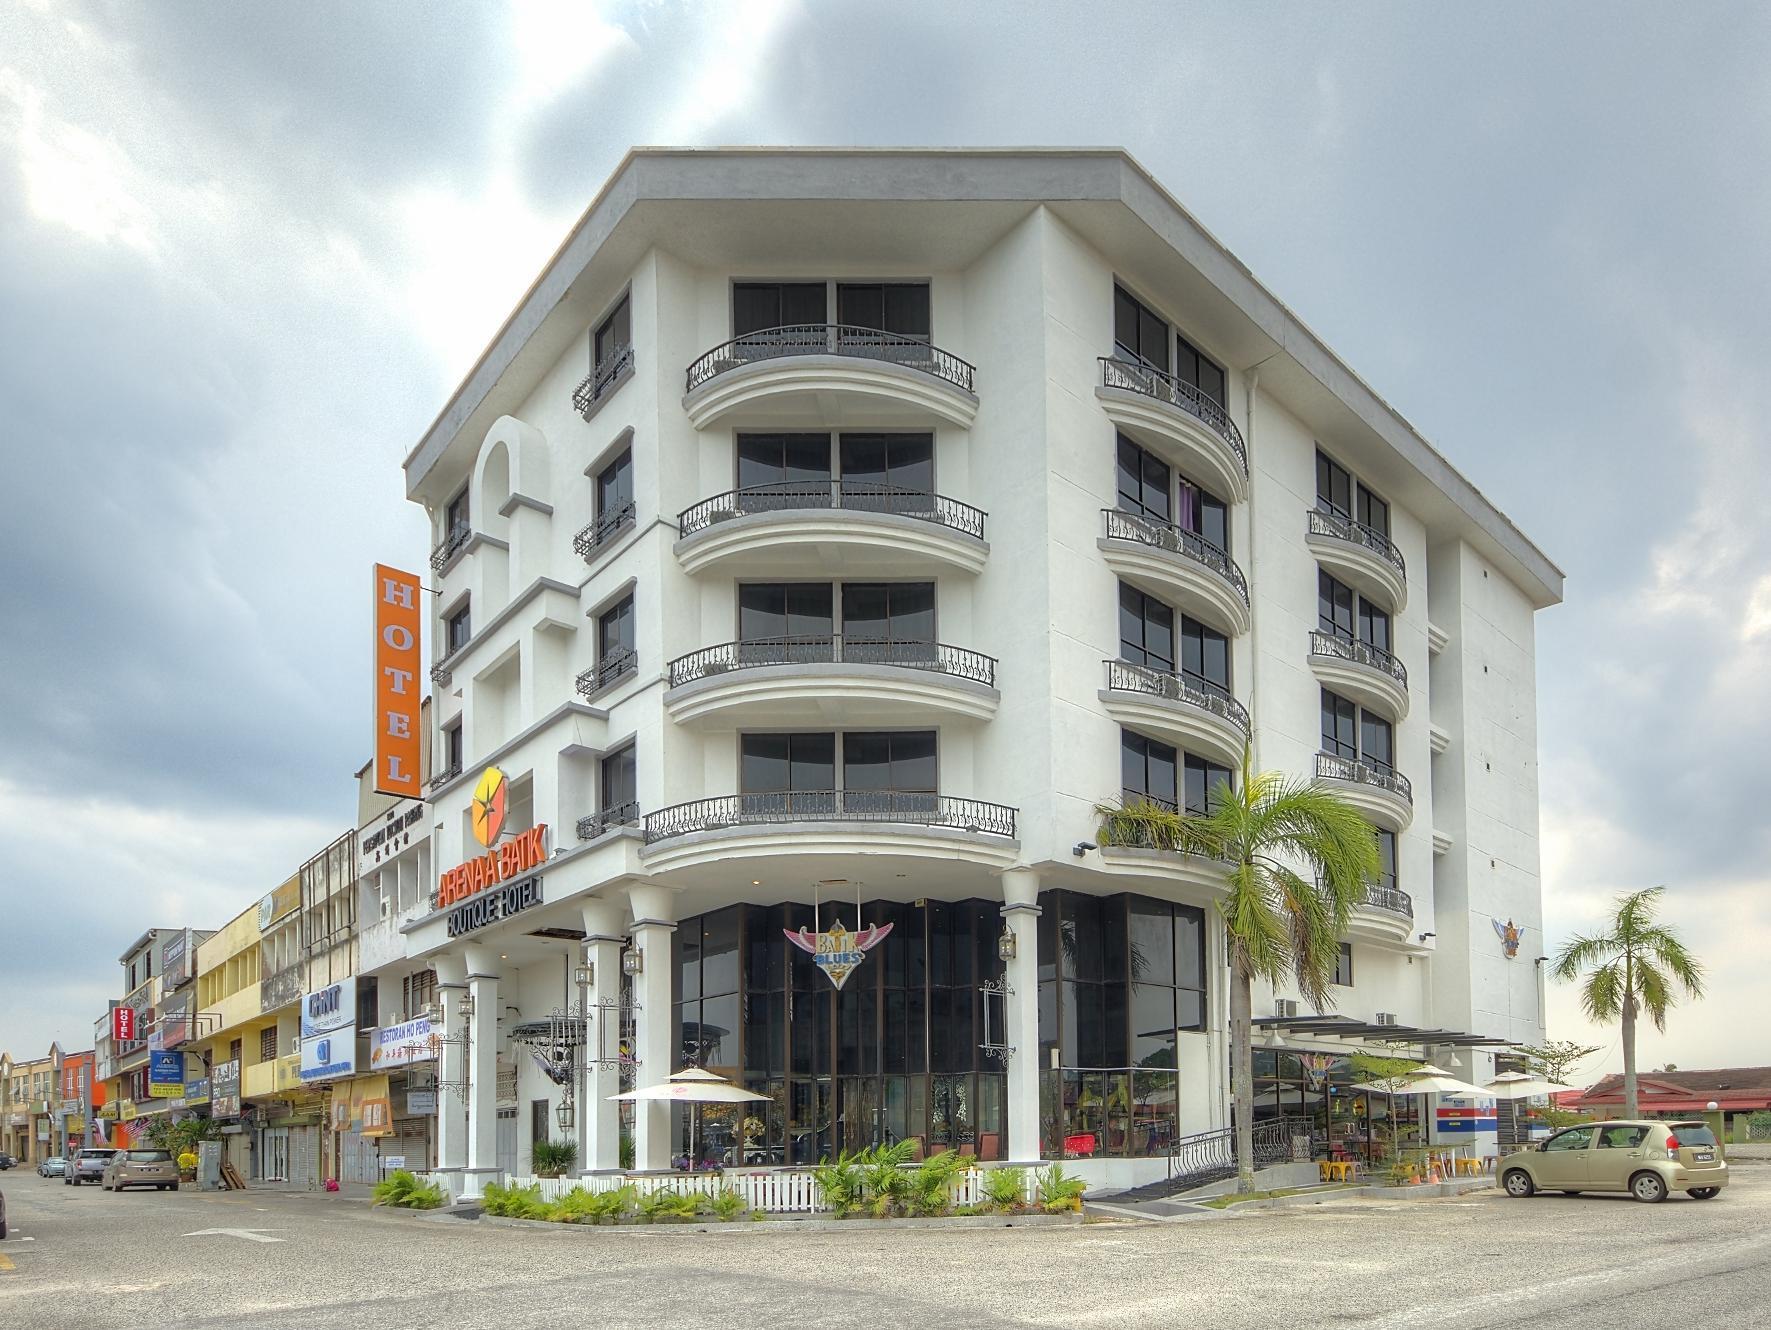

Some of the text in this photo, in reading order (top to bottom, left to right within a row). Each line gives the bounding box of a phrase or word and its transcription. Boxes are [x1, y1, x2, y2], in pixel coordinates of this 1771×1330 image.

[382, 577, 415, 784] HOTEL
[500, 823, 548, 881] BATIK
[447, 877, 541, 938] BOUTIQUE HOTEL
[815, 952, 862, 966] BLUES
[120, 1009, 129, 1039] HOTEL
[379, 1018, 431, 1045] RESTORAN HO PENG
